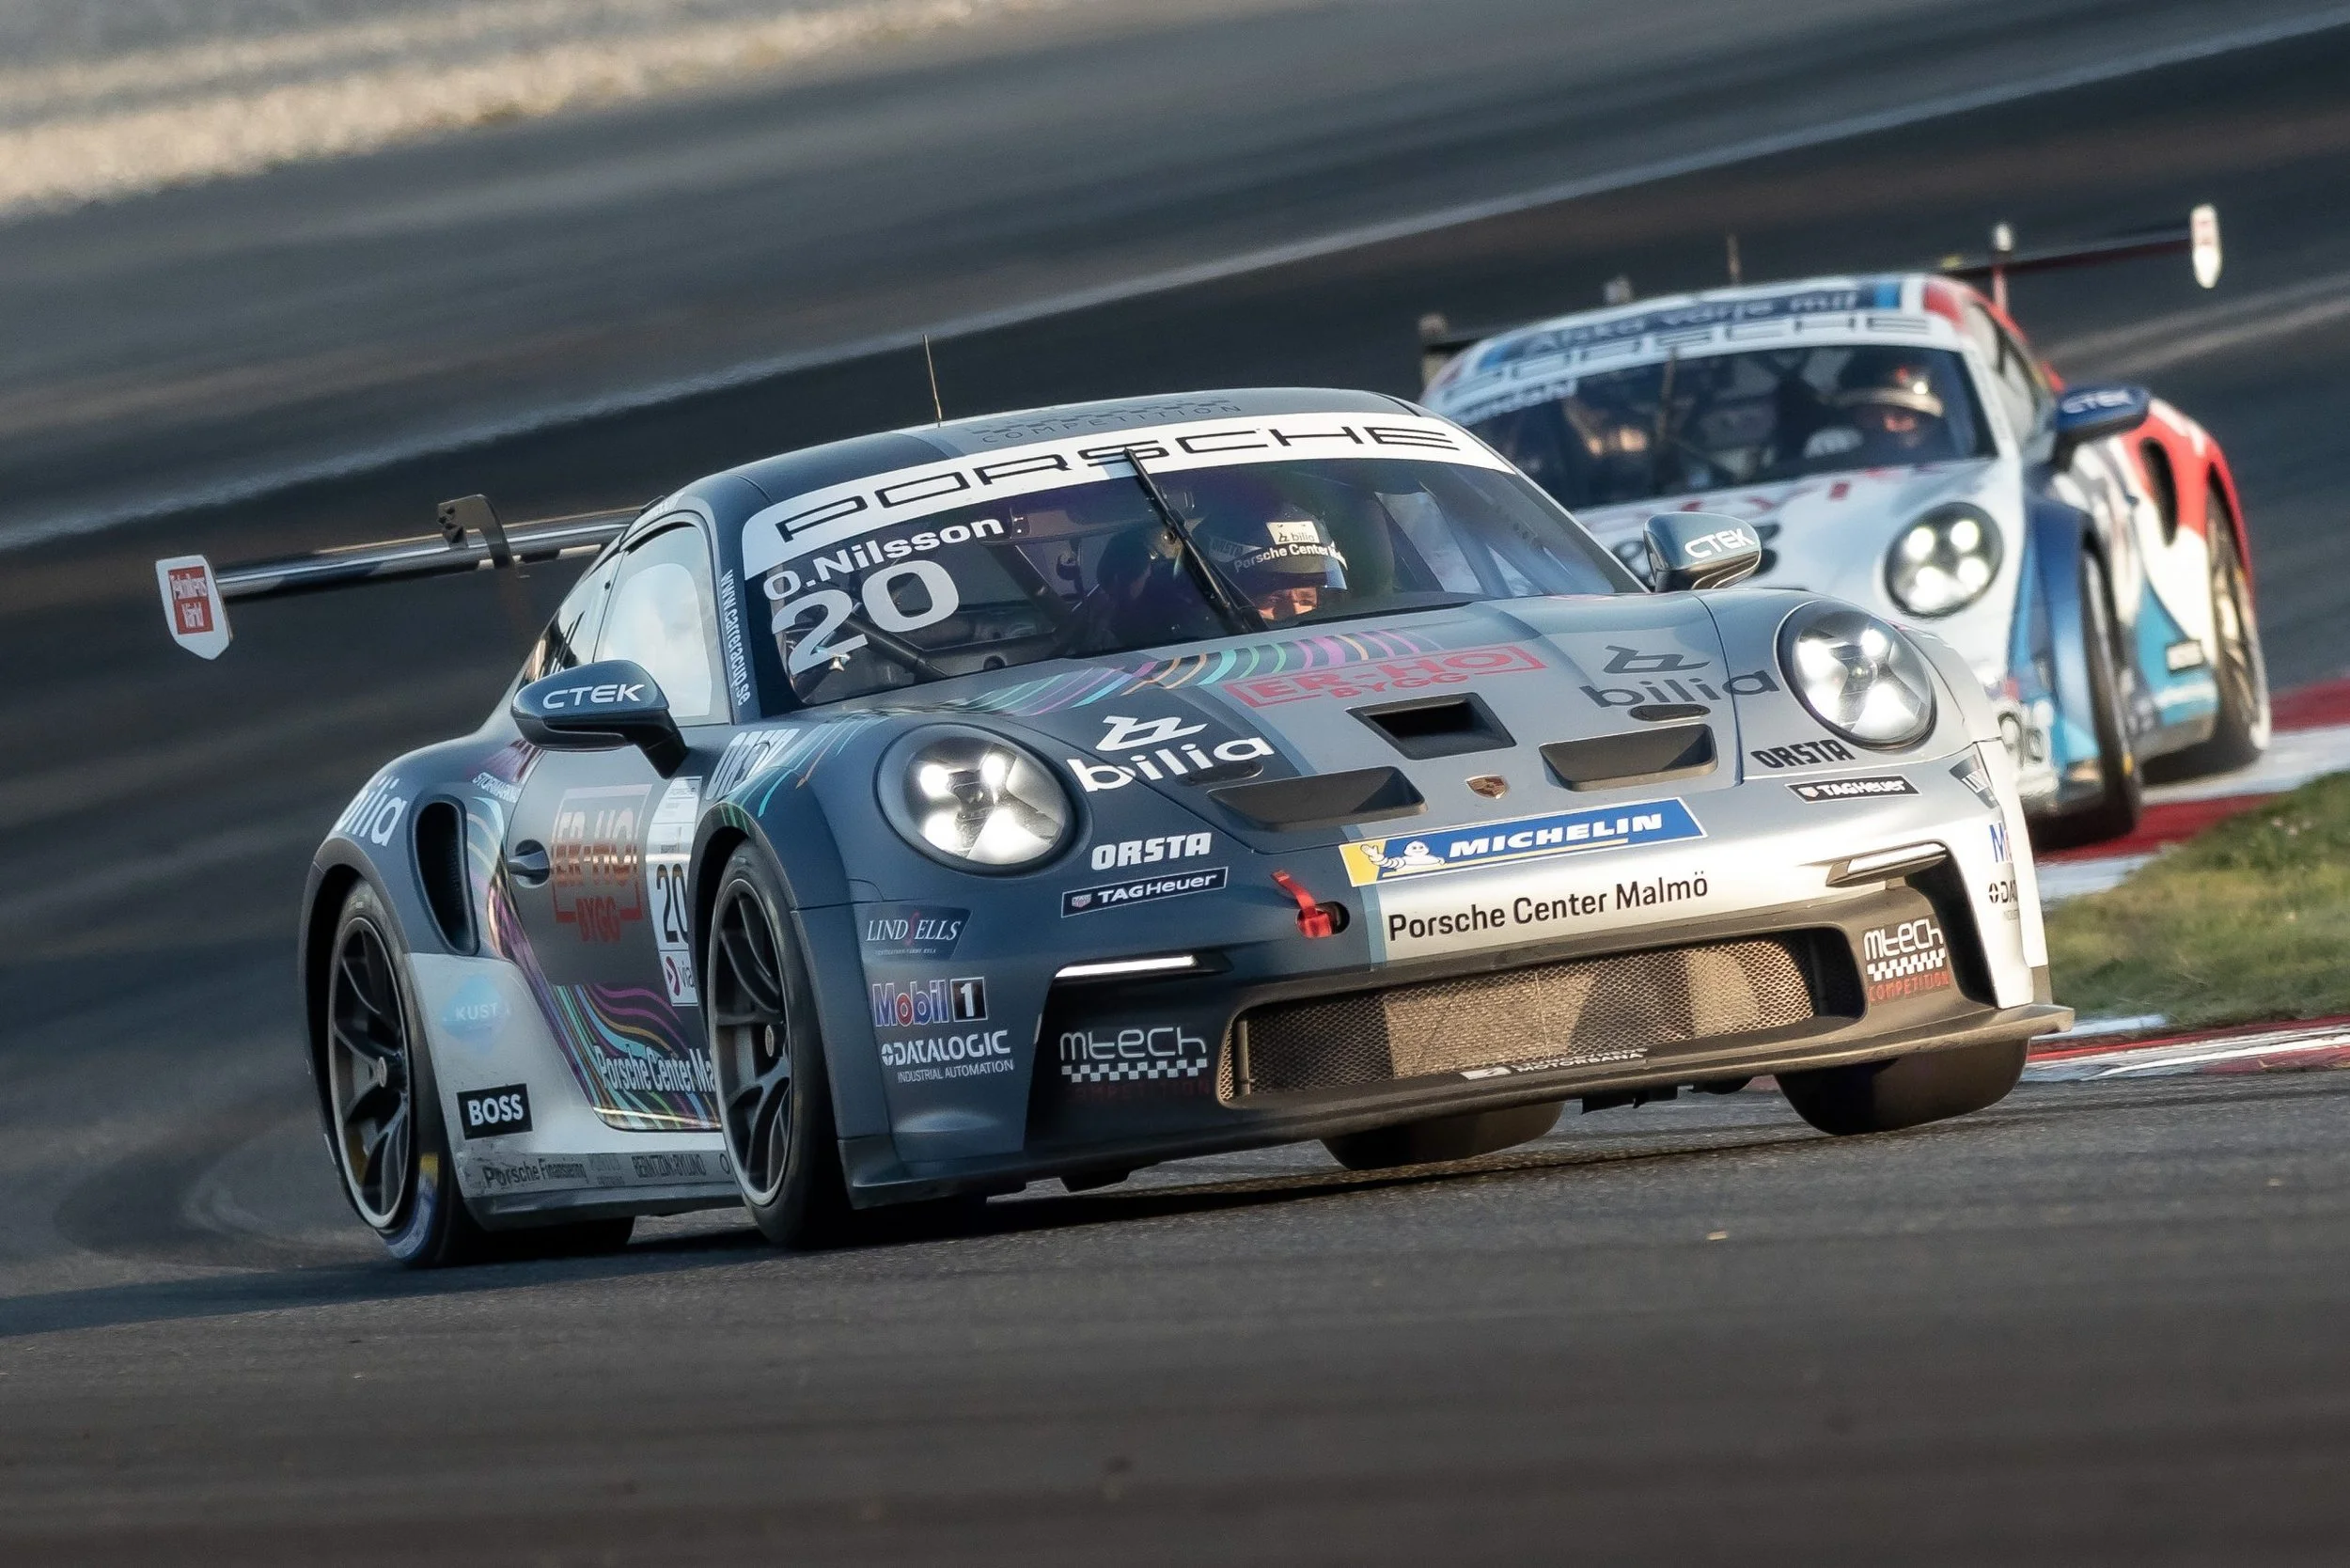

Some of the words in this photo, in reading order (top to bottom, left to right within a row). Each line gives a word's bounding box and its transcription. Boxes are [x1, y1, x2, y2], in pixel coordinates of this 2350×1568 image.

[982, 405, 1241, 443] COMPETITION
[775, 426, 1461, 542] PORSCHE
[763, 516, 1004, 601] O.Nilsson
[1234, 547, 1288, 573] Porsche
[1289, 543, 1329, 557] Center
[1684, 528, 1754, 559] CTEK
[771, 560, 959, 675] 20
[720, 569, 751, 706] www.carreracup.se
[1258, 651, 1512, 698] ER-HO
[1328, 672, 1470, 699] BYGG
[1578, 669, 1779, 709] bilia
[542, 683, 645, 710] CTEK
[1067, 736, 1276, 792] bilia
[1750, 739, 1856, 769] ORSTA
[1090, 832, 1212, 870] ORSTA
[1449, 812, 1662, 858] MICHELIN
[657, 864, 689, 943] 20
[1388, 904, 1506, 942] Porsche
[1513, 892, 1607, 925] Center
[1616, 870, 1709, 910] Malmö
[871, 979, 948, 1027] Mobil
[1869, 970, 1950, 1002] COMPETITION
[455, 1002, 498, 1021] KUST
[894, 1030, 1010, 1066] DATALOGIC
[594, 1045, 651, 1092] Porsche
[646, 1045, 694, 1093] Center
[897, 1066, 944, 1083] INDUSTRIAL
[945, 1058, 1014, 1079] AUTOMATION
[467, 1093, 524, 1127] BOSS
